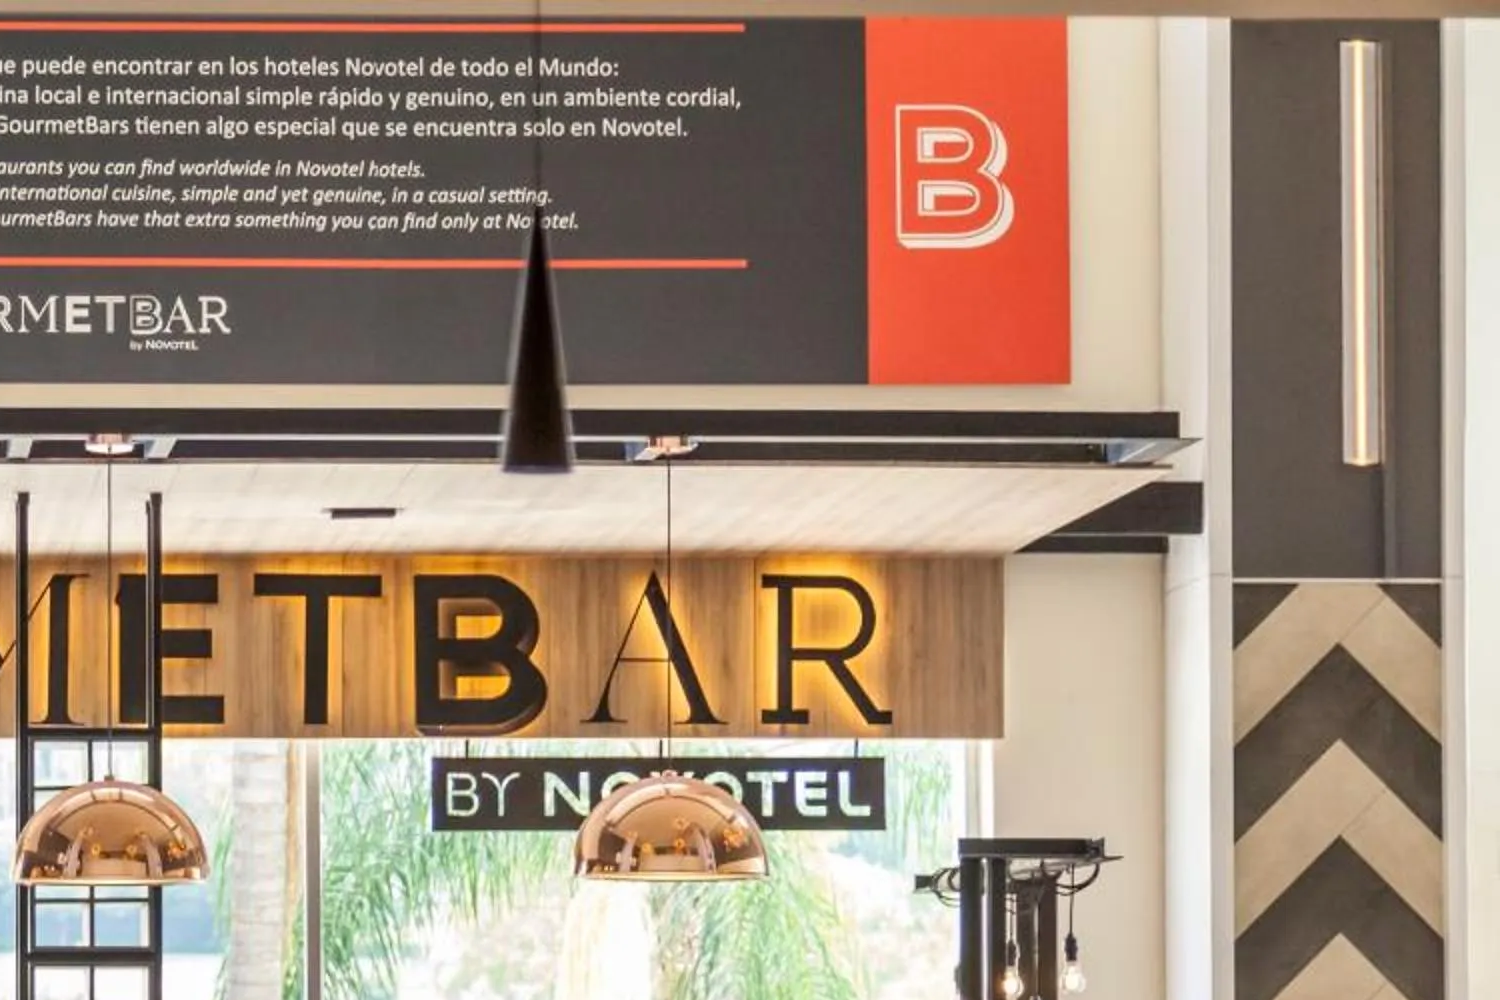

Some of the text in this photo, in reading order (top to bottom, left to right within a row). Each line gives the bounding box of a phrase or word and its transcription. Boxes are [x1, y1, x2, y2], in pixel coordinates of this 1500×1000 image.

[21, 54, 88, 80] puede
[91, 57, 194, 76] encontrar
[197, 60, 224, 76] en
[229, 55, 260, 76] los
[263, 55, 341, 77] hoteles
[344, 56, 425, 78] Novotel
[429, 56, 456, 78] de
[460, 56, 510, 78] todo
[514, 55, 533, 78] el
[539, 56, 619, 78] Mundo:
[34, 84, 82, 106] local
[86, 89, 101, 105] e
[105, 84, 241, 106] internacional
[245, 85, 314, 110] simple
[318, 85, 384, 111] rápido
[387, 91, 401, 112] y
[404, 87, 495, 113] genuino,
[499, 91, 526, 108] en
[531, 91, 559, 107] un
[563, 86, 661, 108] ambiente
[665, 86, 741, 111] cordial,
[134, 115, 201, 136] tienen
[205, 114, 250, 140] algo
[253, 115, 337, 142] especial
[341, 120, 381, 141] que
[384, 121, 408, 138] se
[412, 119, 518, 139] encuentra
[522, 116, 566, 138] solo
[569, 121, 597, 138] en
[601, 116, 688, 138] Novotel.
[67, 162, 101, 179] you
[104, 162, 137, 176] can
[139, 158, 175, 180] find
[179, 159, 272, 177] worldwide
[275, 160, 292, 178] in
[296, 160, 365, 178] Novotel
[368, 160, 427, 179] hotels.
[895, 104, 1015, 249] B
[111, 184, 178, 205] cuisine,
[181, 184, 240, 206] simple
[243, 185, 278, 203] and
[280, 187, 310, 207] yet
[313, 186, 388, 208] genuine,
[392, 186, 409, 204] in
[412, 190, 425, 205] a
[428, 186, 485, 205] casual
[488, 187, 554, 207] setting.
[97, 209, 139, 228] have
[143, 210, 182, 228] that
[184, 212, 232, 229] extra
[235, 211, 328, 233] something
[331, 215, 365, 233] you
[368, 216, 400, 231] can
[402, 212, 438, 235] find
[441, 212, 480, 233] only
[482, 214, 502, 230] at
[506, 213, 580, 231] Nootel.
[145, 339, 199, 351] NOVOTEL
[446, 772, 521, 817] BY
